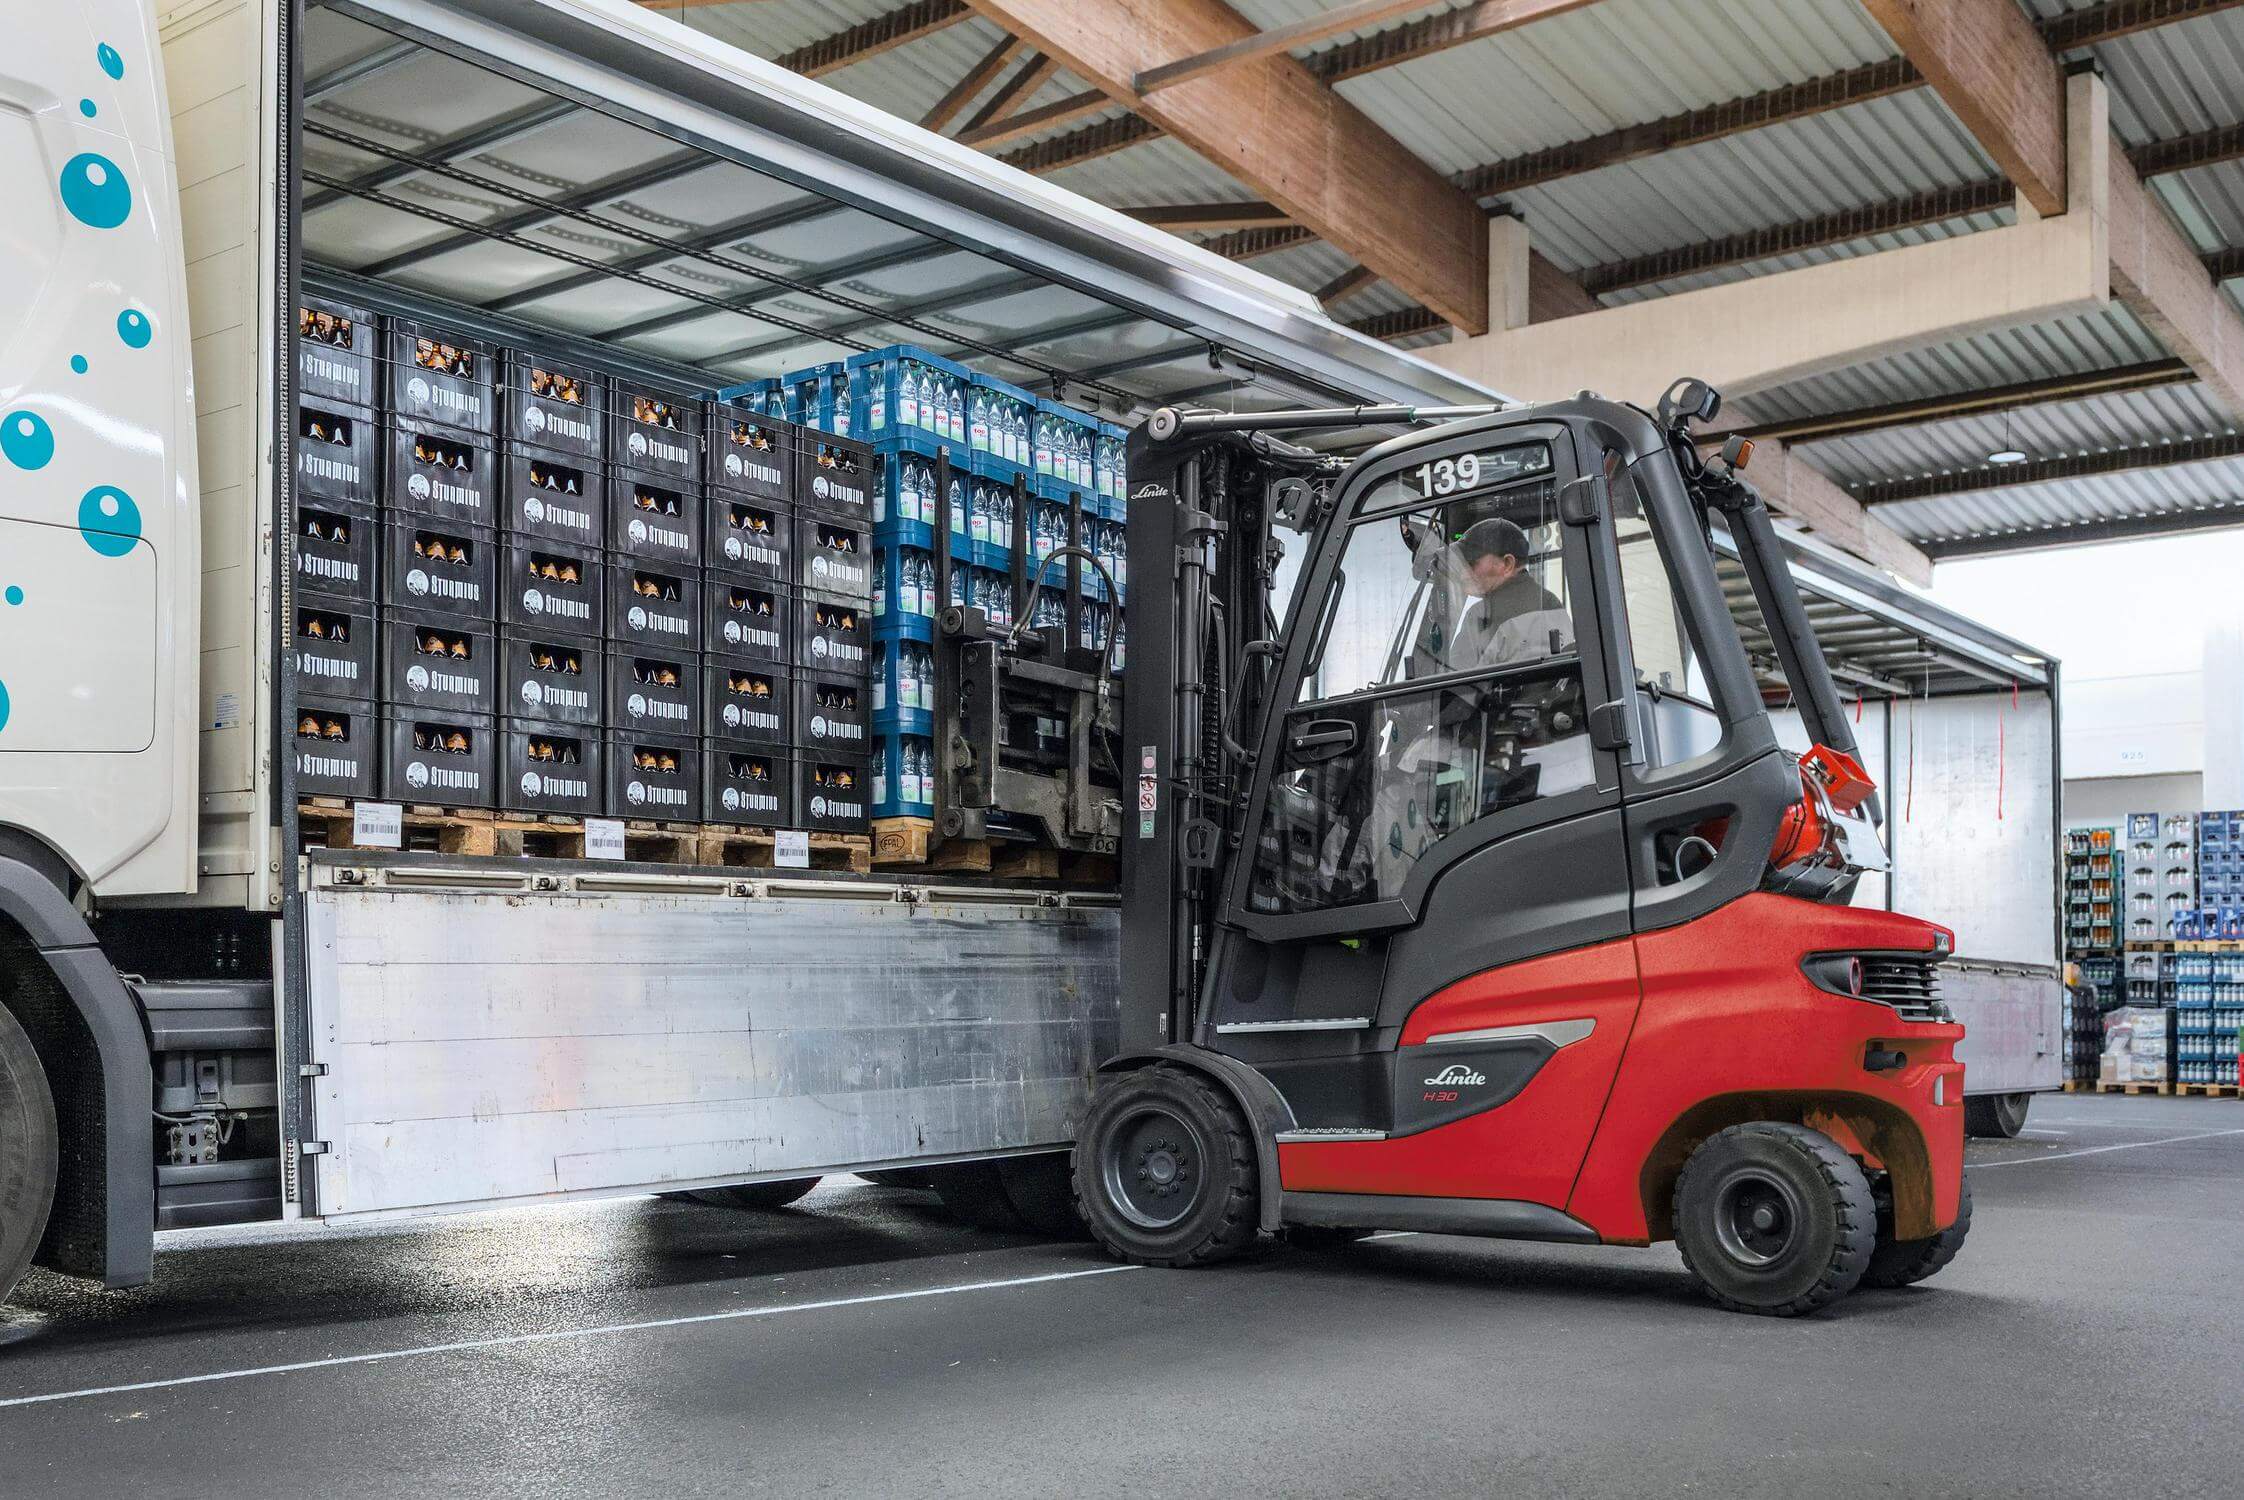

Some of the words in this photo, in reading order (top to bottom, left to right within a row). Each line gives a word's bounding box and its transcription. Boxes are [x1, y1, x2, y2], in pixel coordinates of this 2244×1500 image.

[1415, 453, 1480, 498] 139
[1130, 483, 1168, 499] Linde
[1424, 1064, 1486, 1086] Linde
